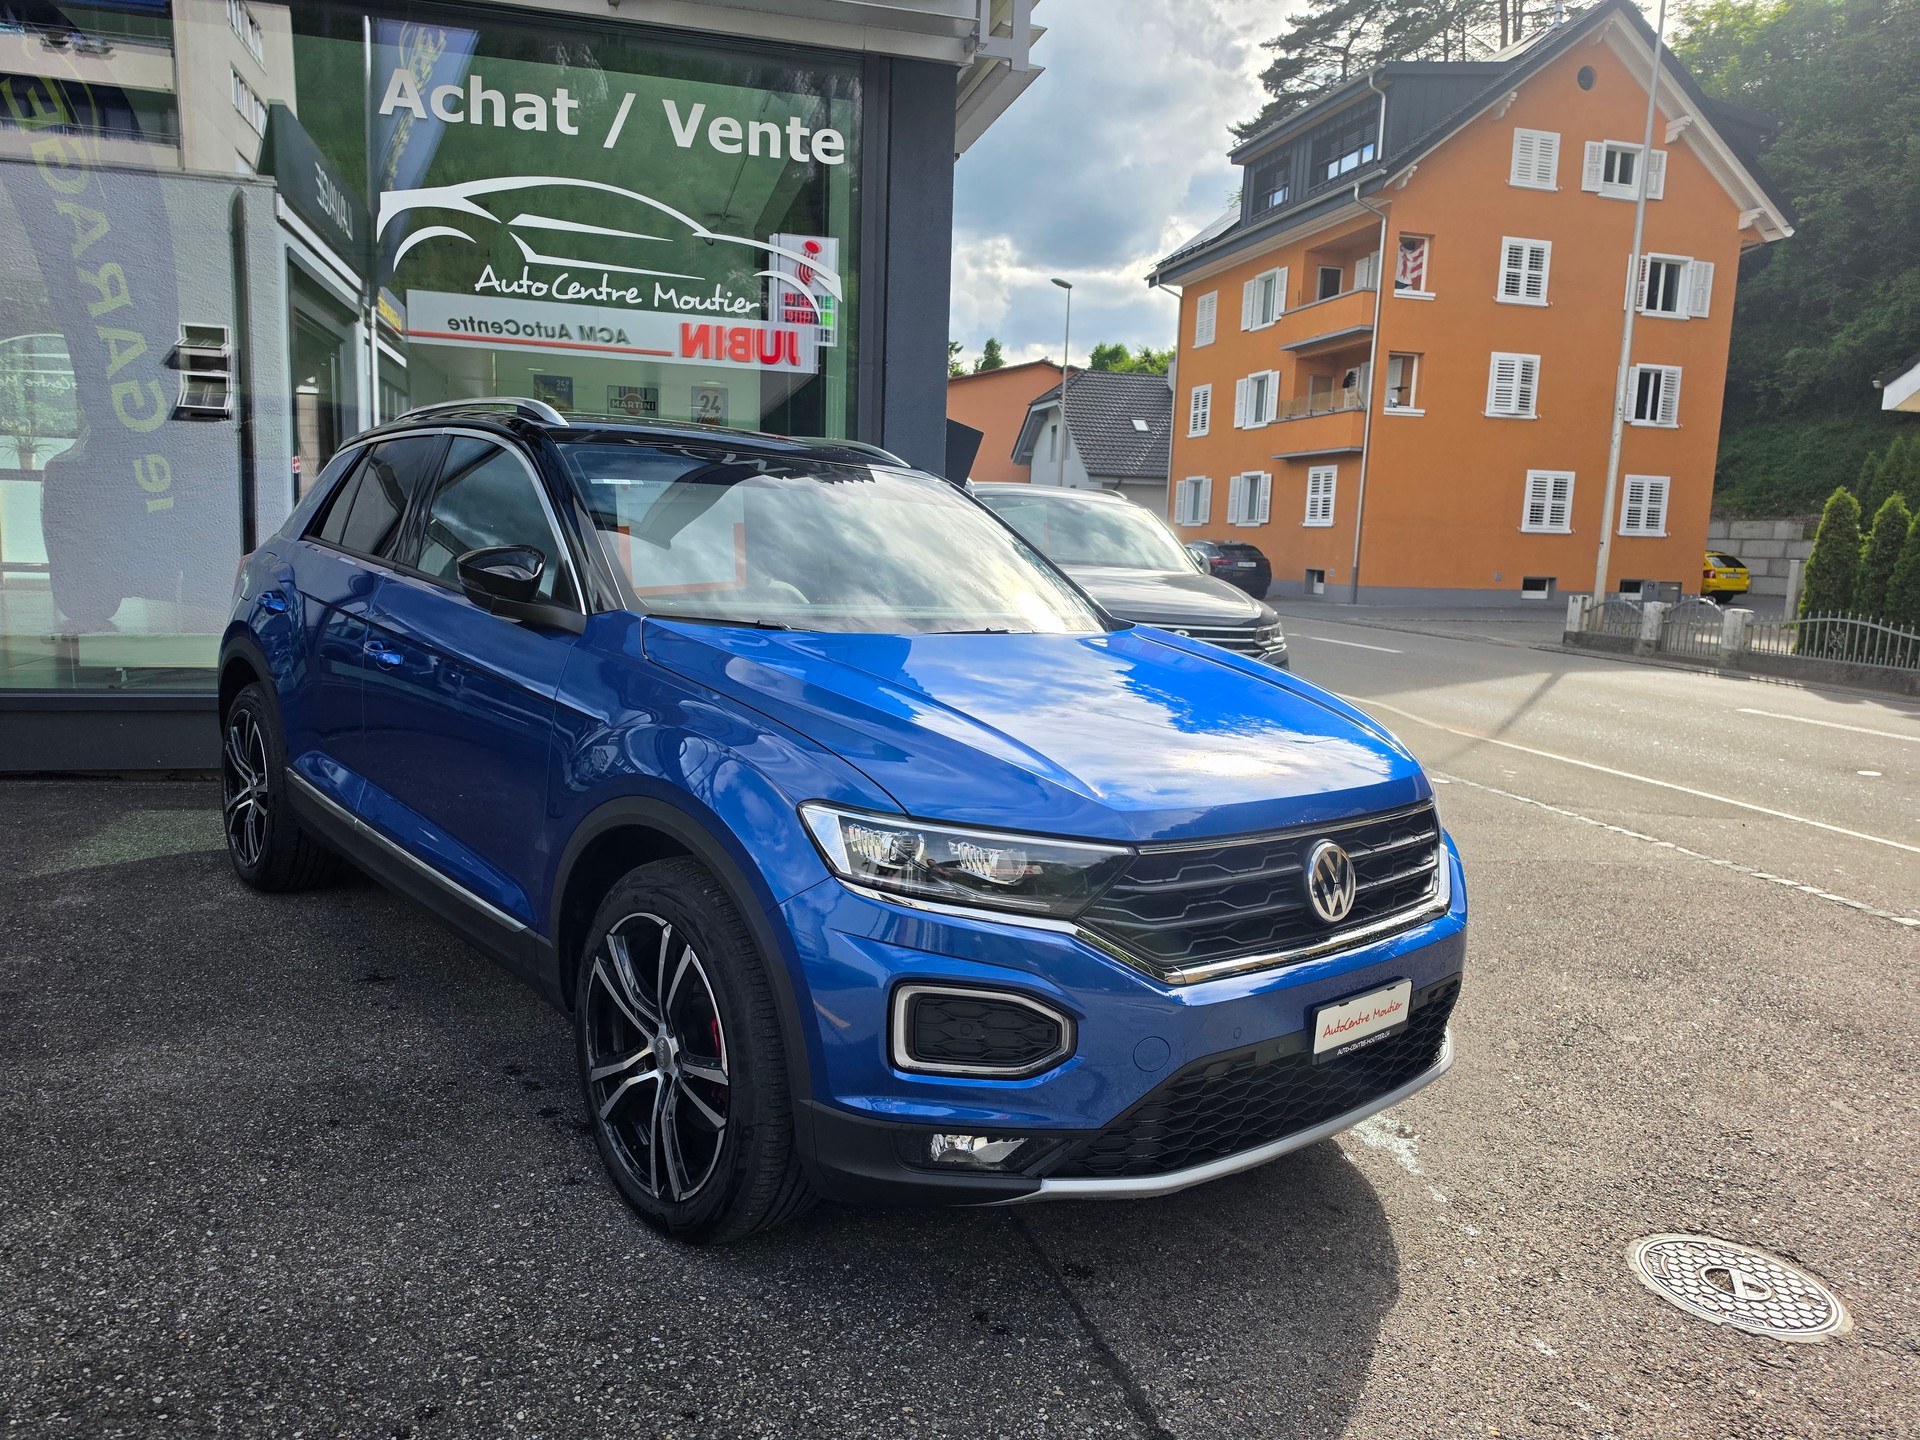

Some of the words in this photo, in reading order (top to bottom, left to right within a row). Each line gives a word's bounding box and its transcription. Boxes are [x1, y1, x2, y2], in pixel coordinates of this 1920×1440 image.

[378, 68, 579, 136] Achat
[603, 92, 636, 149] /
[662, 100, 846, 166] Vente
[653, 282, 760, 313] Moutier
[611, 399, 655, 410] MARTINI
[700, 394, 721, 413] 24
[1372, 1000, 1403, 1020] Moutier
